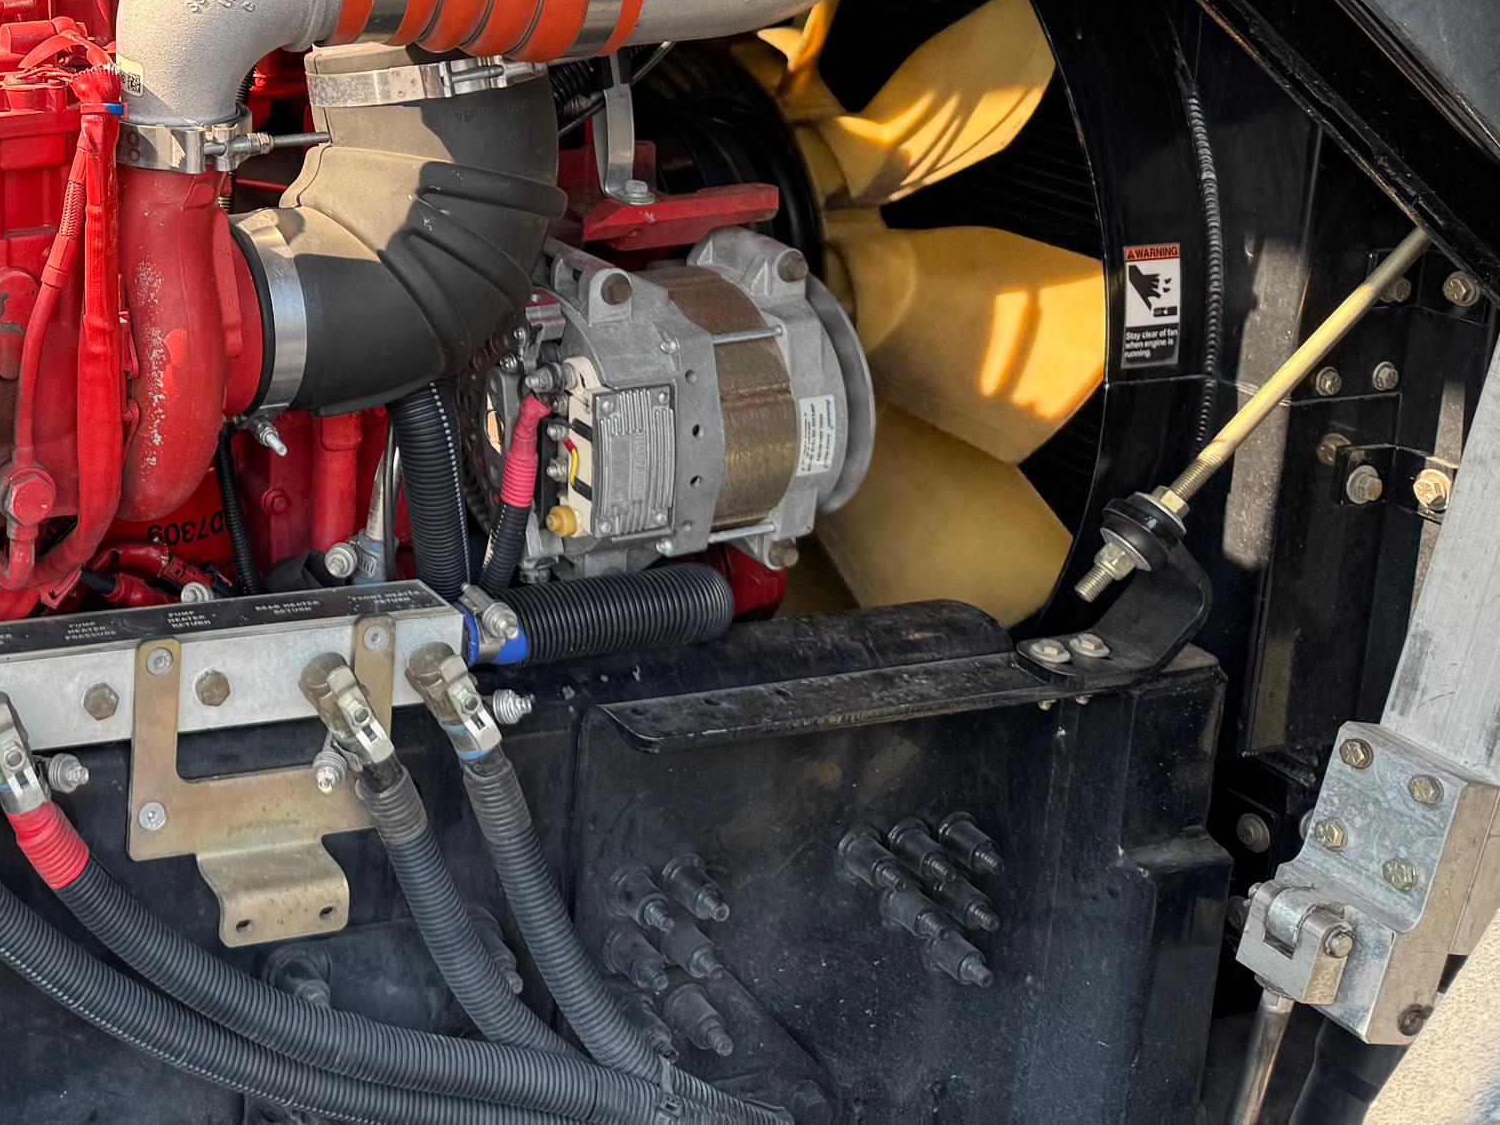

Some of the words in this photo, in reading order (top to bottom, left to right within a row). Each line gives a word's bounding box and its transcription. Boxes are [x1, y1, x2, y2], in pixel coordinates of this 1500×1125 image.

[1135, 246, 1178, 259] WARNING
[1126, 331, 1141, 341] Stay
[1142, 330, 1158, 339] clear
[1159, 328, 1167, 337] of
[1167, 327, 1178, 337] fan
[1125, 341, 1144, 349] when
[1144, 338, 1167, 349] engine
[352, 593, 382, 602] FRONT
[385, 589, 422, 598] HEATER
[373, 596, 411, 605] RETURN
[255, 603, 280, 611] REAR
[282, 600, 320, 608] HEATER
[168, 610, 195, 618] PUMP
[274, 606, 312, 615] RETURN
[167, 614, 207, 623] HEATER
[171, 619, 211, 628] RETURN
[67, 625, 106, 634] HEATER
[64, 630, 117, 640] PRESSURE
